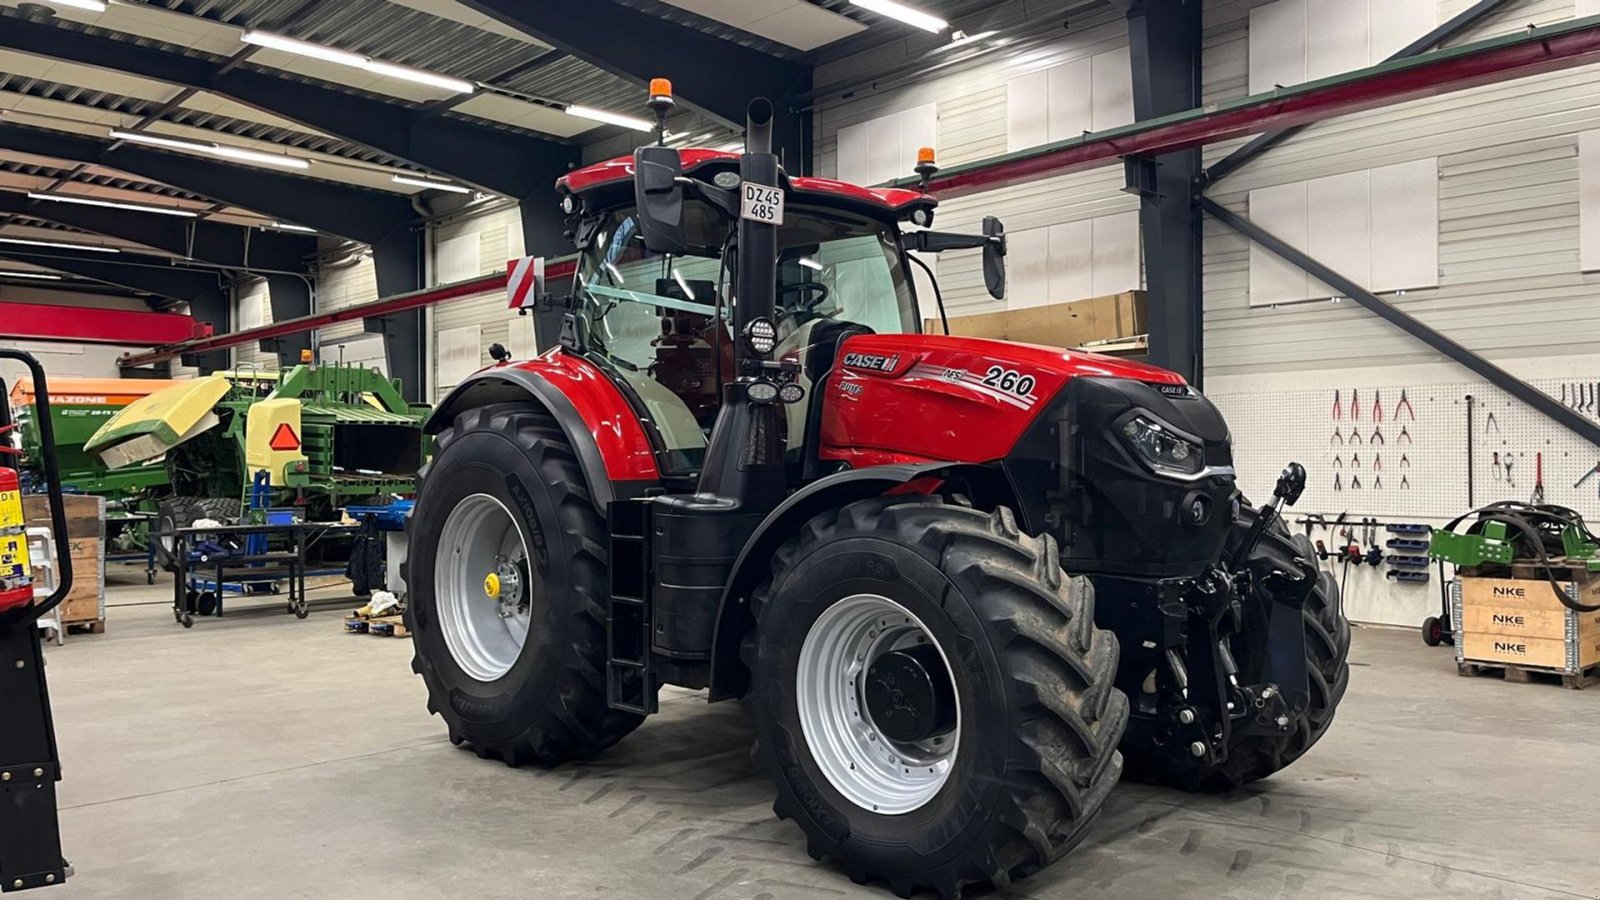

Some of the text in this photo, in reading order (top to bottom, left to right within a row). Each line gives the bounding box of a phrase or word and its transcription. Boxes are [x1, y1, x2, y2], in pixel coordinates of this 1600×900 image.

[751, 203, 774, 220] 485
[843, 353, 883, 369] CASE
[982, 366, 1034, 396] 260
[1161, 386, 1176, 394] CASE
[1493, 587, 1526, 597] NKE
[1492, 614, 1525, 625] NKE
[1494, 642, 1526, 653] NKE
